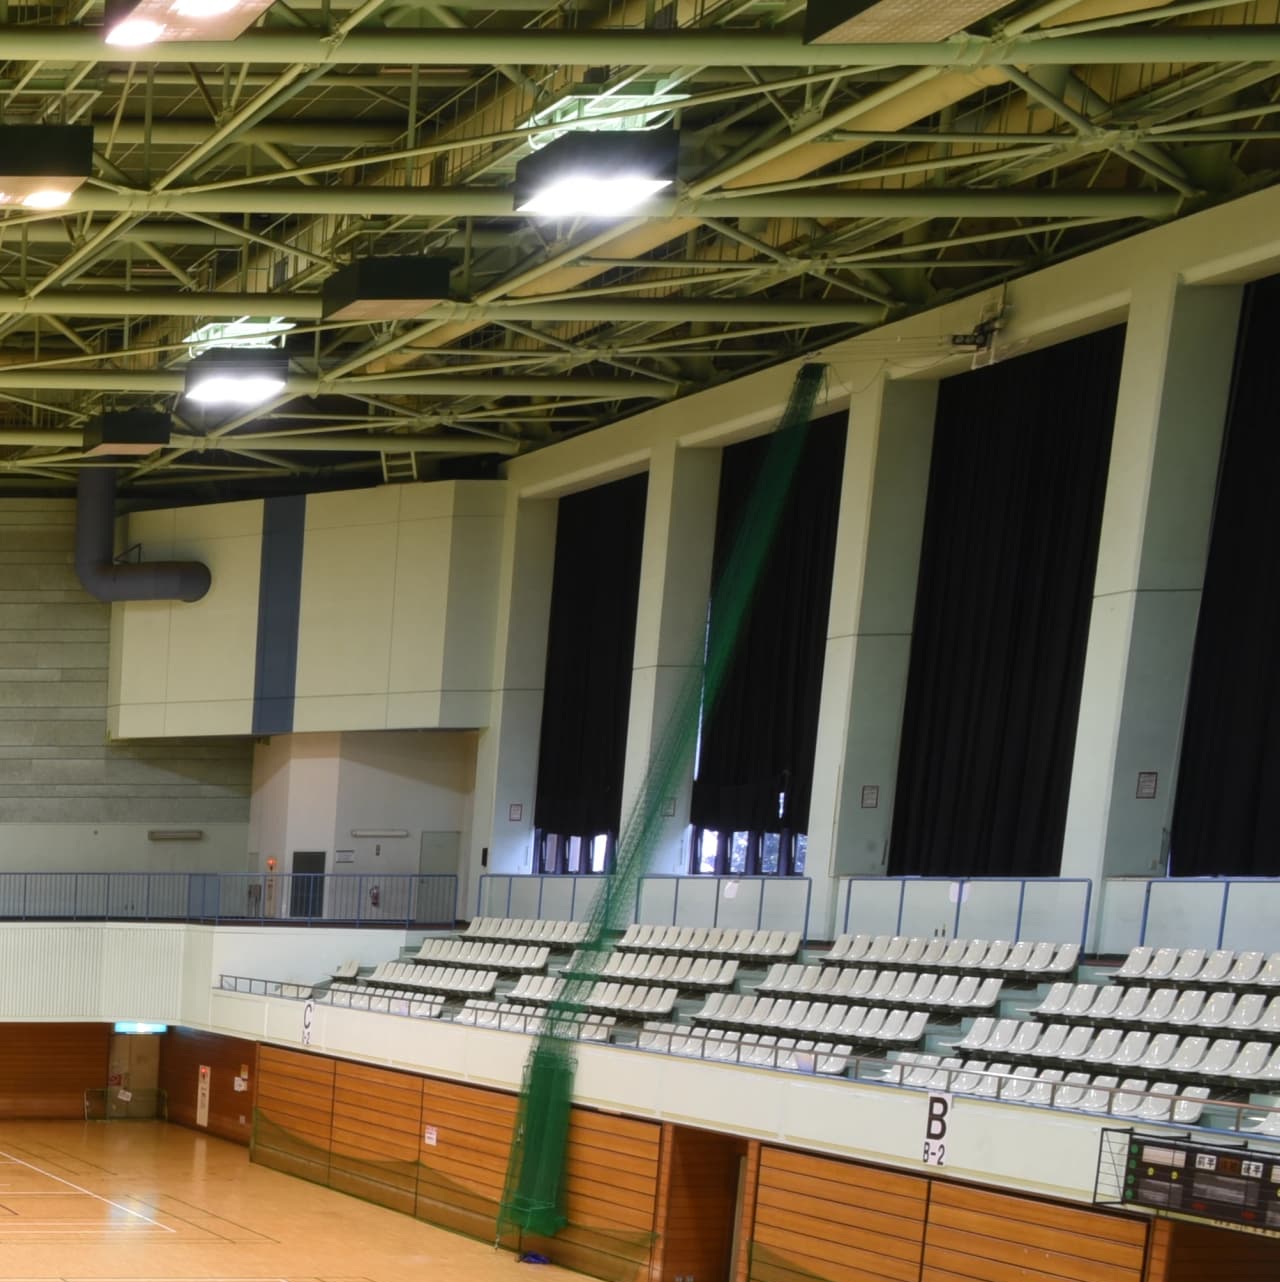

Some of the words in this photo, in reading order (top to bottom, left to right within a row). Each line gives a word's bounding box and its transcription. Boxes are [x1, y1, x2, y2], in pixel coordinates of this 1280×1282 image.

[304, 1003, 312, 1029] C
[926, 1096, 948, 1141] B
[923, 1141, 945, 1166] B-2
